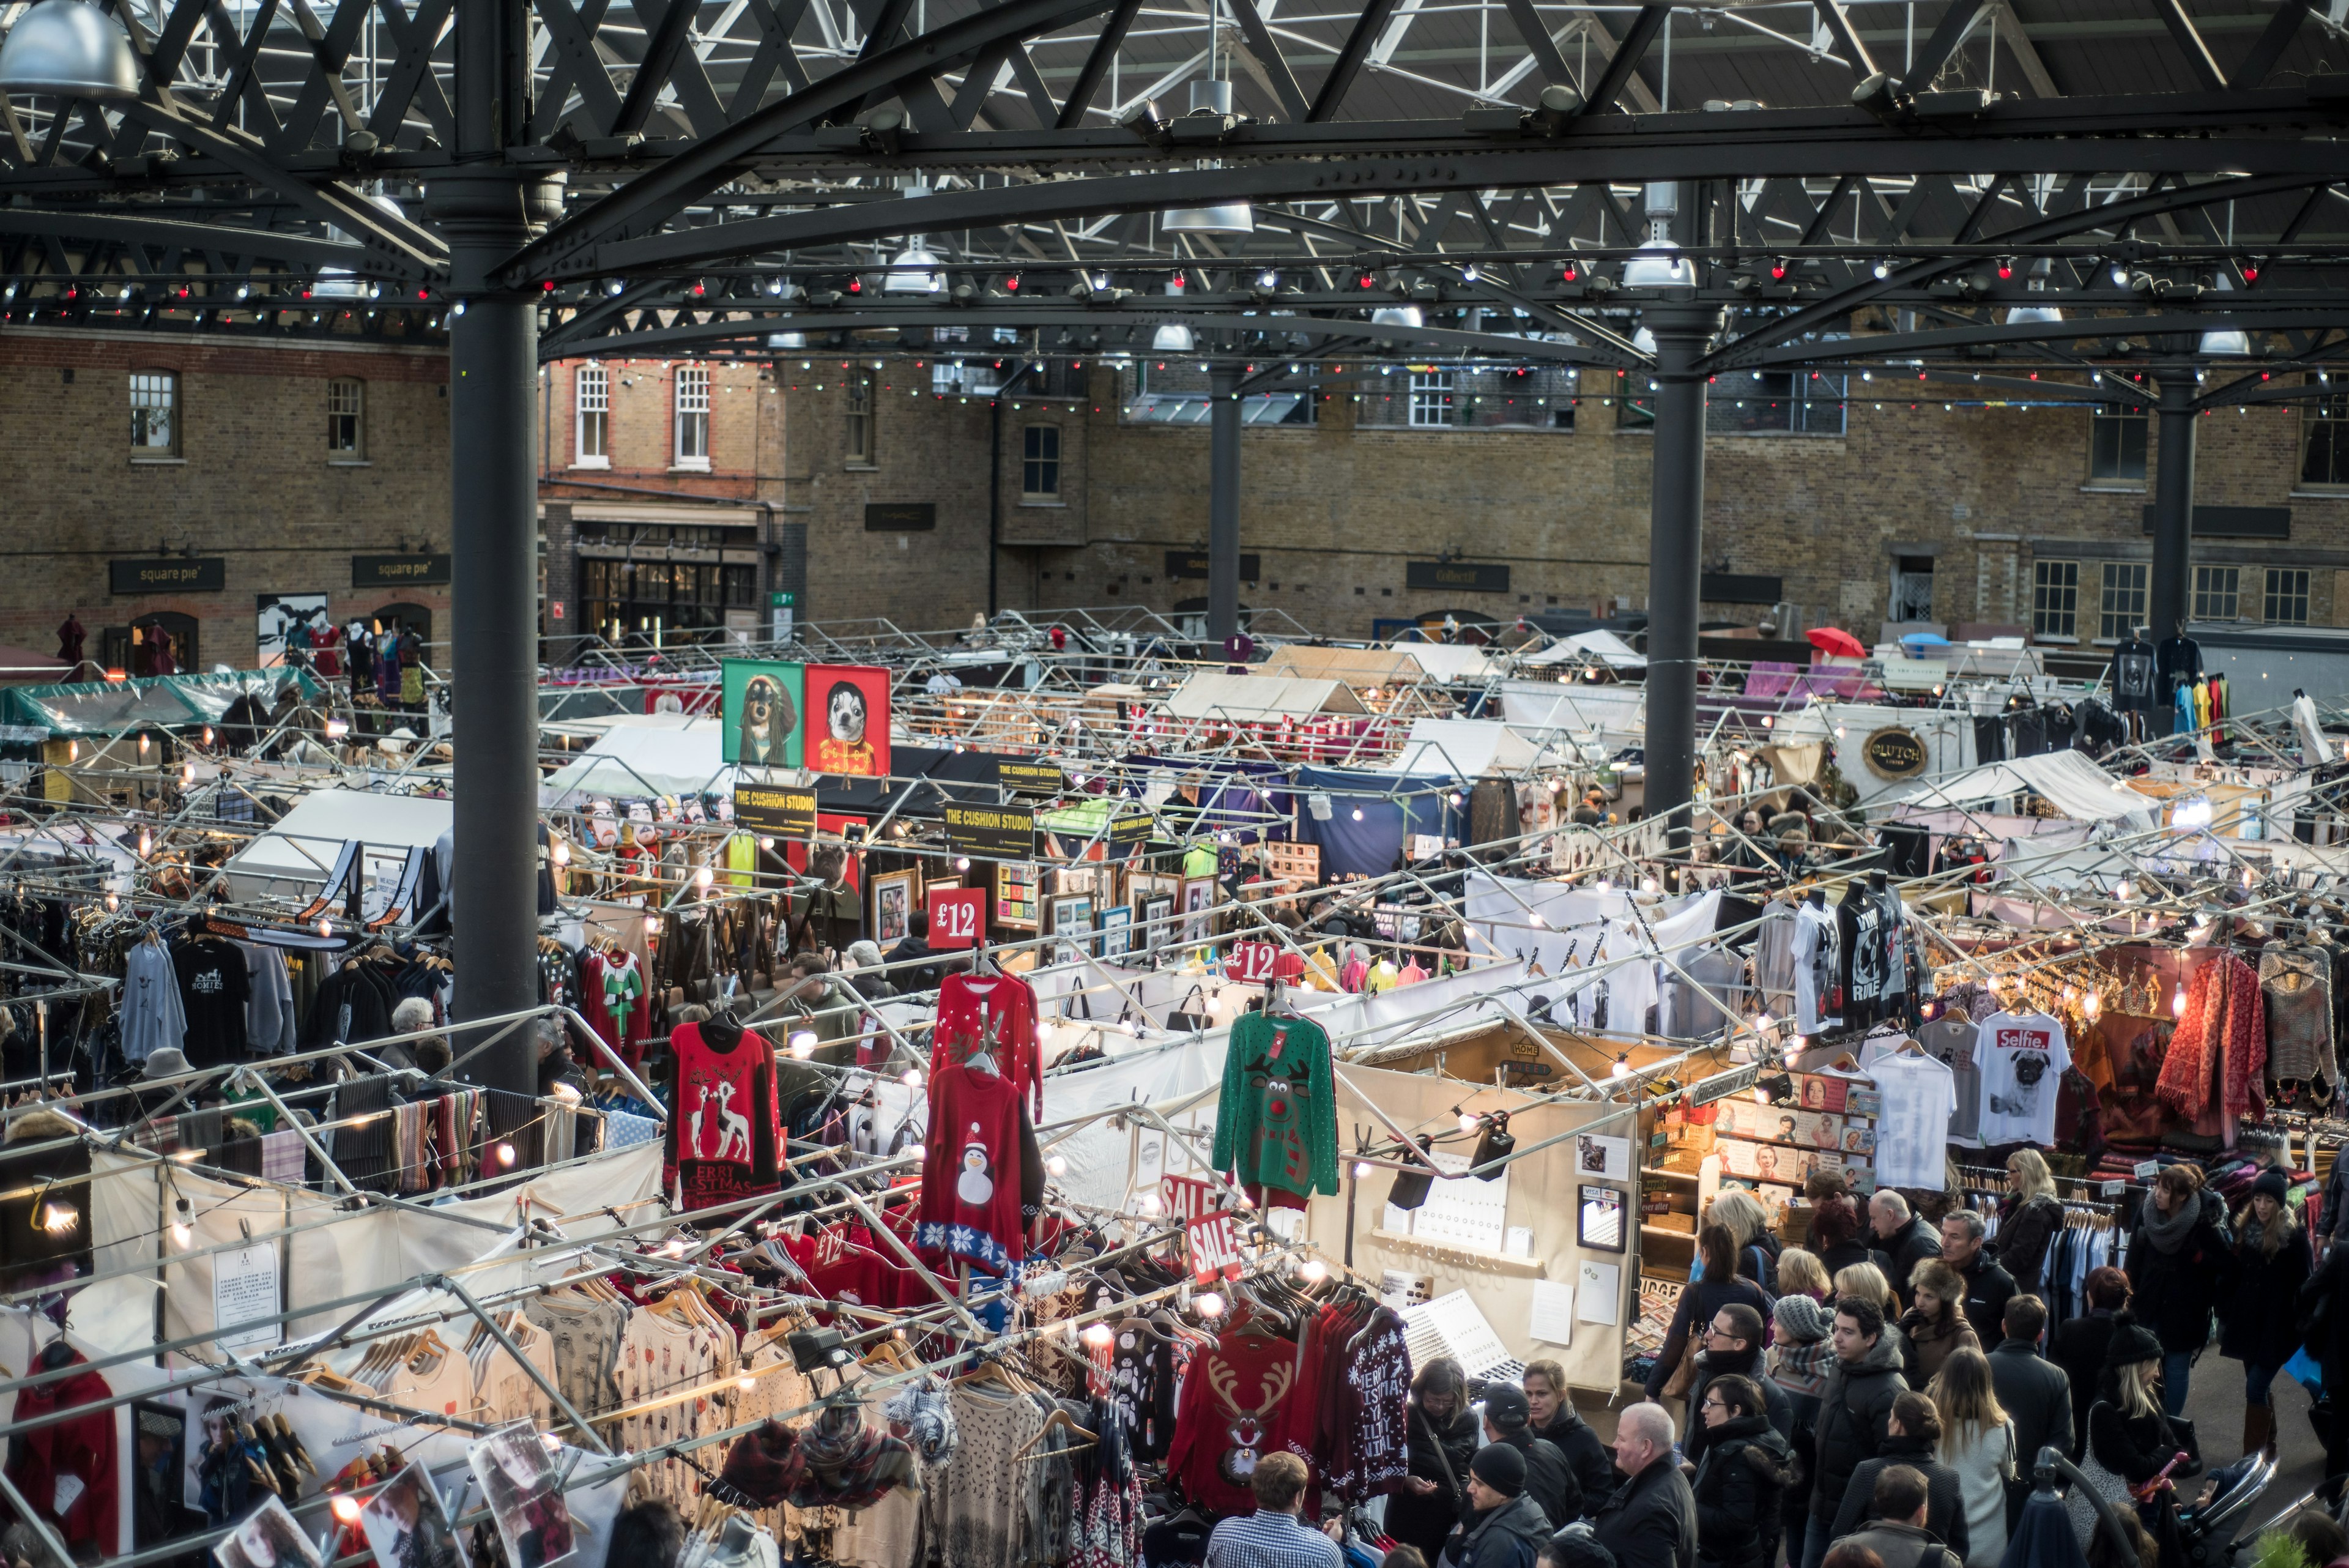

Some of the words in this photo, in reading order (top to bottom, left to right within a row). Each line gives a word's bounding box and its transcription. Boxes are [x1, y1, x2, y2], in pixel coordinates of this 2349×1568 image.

[140, 569, 179, 583] square
[378, 564, 412, 577] square
[1872, 744, 1919, 762] CLUTCH
[1000, 765, 1011, 774] THE
[1012, 766, 1038, 776] CUSHION
[1039, 768, 1061, 778] STUDIO
[735, 790, 750, 805] THE
[751, 791, 785, 808] CUSHION
[786, 795, 815, 811] STUDIO
[946, 808, 962, 825] THE
[963, 810, 1000, 828] CUSHION
[1002, 814, 1032, 831] STUDIO
[1111, 822, 1119, 831] THE
[1119, 819, 1138, 830] CUSHION
[1138, 817, 1154, 827] STUDIO
[386, 878, 398, 886] ACCEPT
[937, 903, 975, 937] £12
[1224, 943, 1275, 980] £12
[1853, 979, 1880, 1001] RULE
[2001, 1031, 2046, 1049] Selfie.
[1514, 1044, 1538, 1055] HOME
[1699, 1073, 1742, 1100] HIGHBURY
[1666, 1113, 1681, 1123] NICE
[1667, 1131, 1679, 1142] OR
[1664, 1153, 1680, 1165] LEAVE
[697, 1165, 734, 1180] ERRY
[689, 1176, 752, 1192] CSTMAS
[1644, 1179, 1668, 1190] happily
[1162, 1178, 1216, 1221] SALE
[817, 1228, 844, 1266] £12
[1190, 1216, 1238, 1274] SALE
[1639, 1278, 1679, 1298] IDGE
[1364, 1377, 1402, 1405] ISTMA
